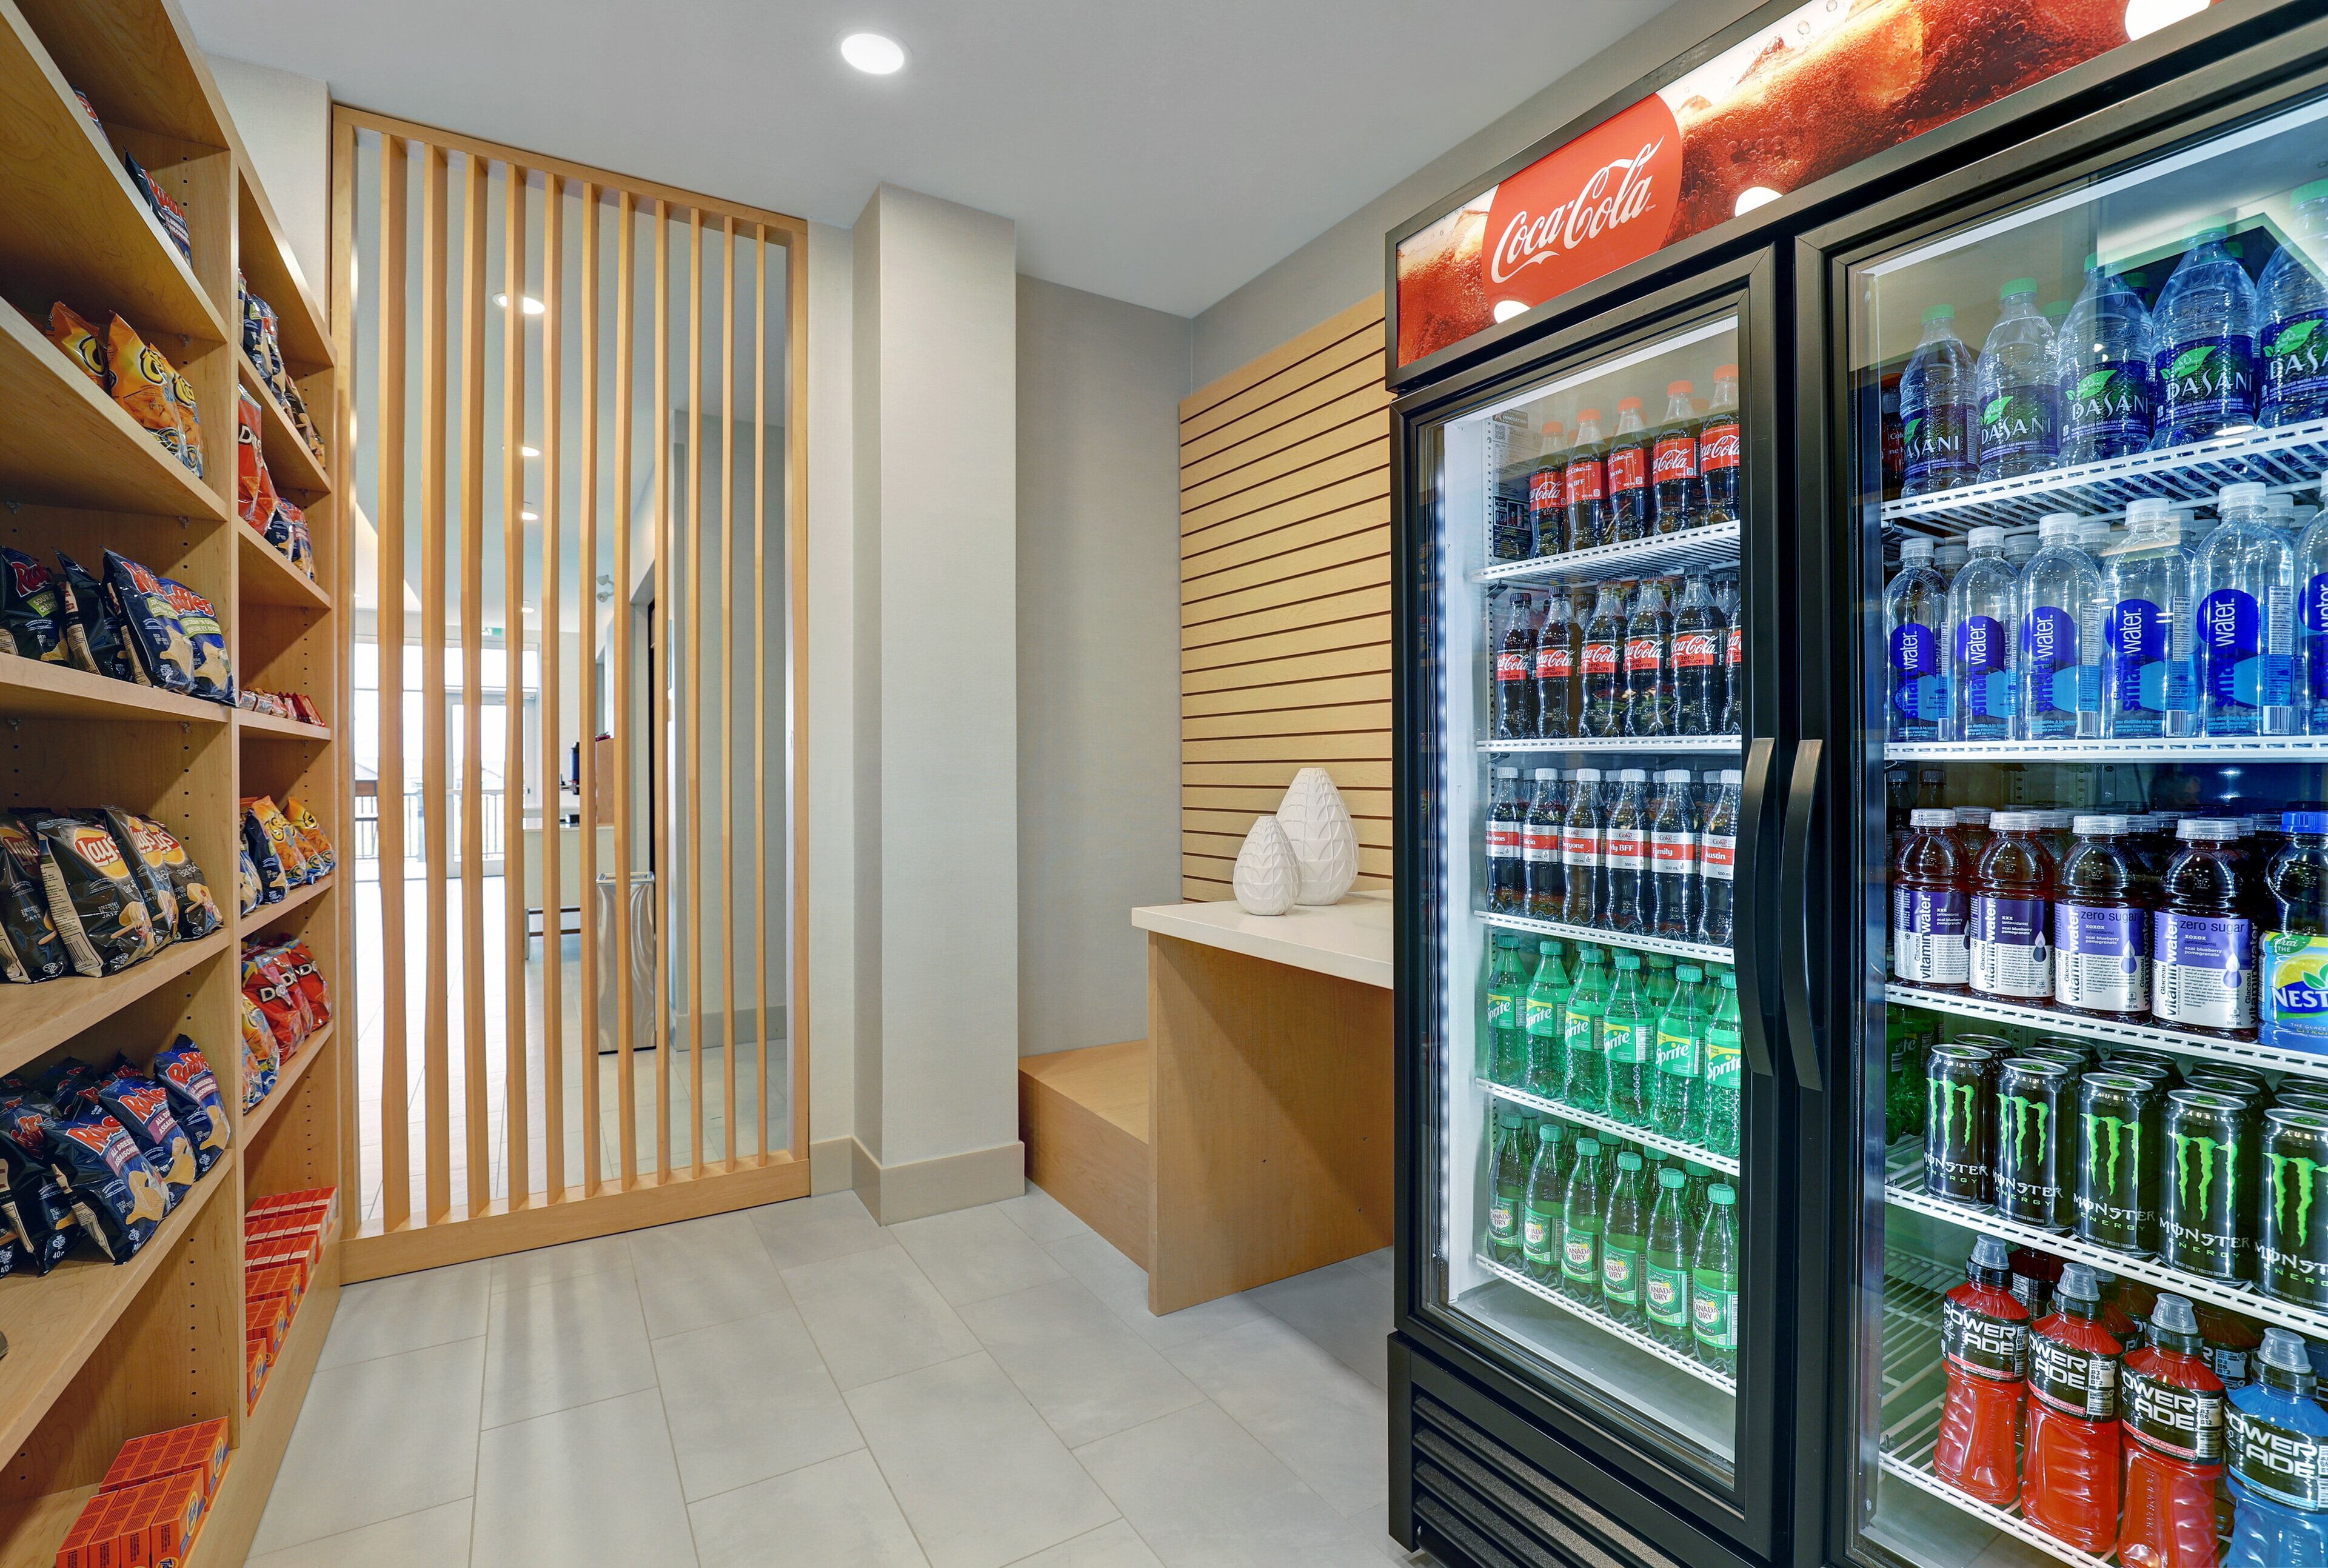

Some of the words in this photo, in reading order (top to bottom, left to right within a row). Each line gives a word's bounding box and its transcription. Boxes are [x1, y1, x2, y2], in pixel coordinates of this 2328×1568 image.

[1491, 135, 1665, 284] Coca-Cola
[2167, 367, 2252, 402] DASANI
[2071, 390, 2149, 421] DASANI
[1981, 416, 2052, 445] DASANI
[1904, 435, 1959, 462] ASANI
[1574, 478, 1585, 487] BFF
[1610, 844, 1618, 852] My
[1705, 850, 1726, 860] Austin
[2081, 910, 2105, 921] zero
[2109, 912, 2139, 923] sugar
[2179, 919, 2207, 931] zero
[2210, 922, 2245, 935] sugar
[1656, 1042, 1690, 1067] Sprite
[1934, 1056, 1973, 1069] TAURINE
[1707, 1054, 1741, 1082] Sprit
[2004, 1072, 2047, 1086] TAURINE
[1924, 1152, 1988, 1177] MONSTER
[1925, 1166, 1978, 1184] ENERGY
[1995, 1186, 2052, 1207] ENERGY
[2073, 1192, 2156, 1223] MONSTER
[2080, 1211, 2146, 1232] ENERGY
[2159, 1216, 2250, 1249] MONSTER
[1565, 1246, 1592, 1255] CANADA
[2168, 1236, 2241, 1259] ENERGY
[1608, 1270, 1622, 1279] DRY
[1648, 1284, 1675, 1295] CANADA
[1653, 1292, 1668, 1301] DRY
[1698, 1311, 1712, 1320] DRY
[1943, 1301, 2016, 1341] POWER
[1964, 1333, 2015, 1356] ADE
[2029, 1333, 2088, 1374] OWER
[2035, 1356, 2086, 1392] ADE
[2122, 1371, 2197, 1413] OWER
[2135, 1396, 2196, 1432] ADE
[2224, 1405, 2318, 1458] POWER
[2246, 1443, 2316, 1480] ADE
